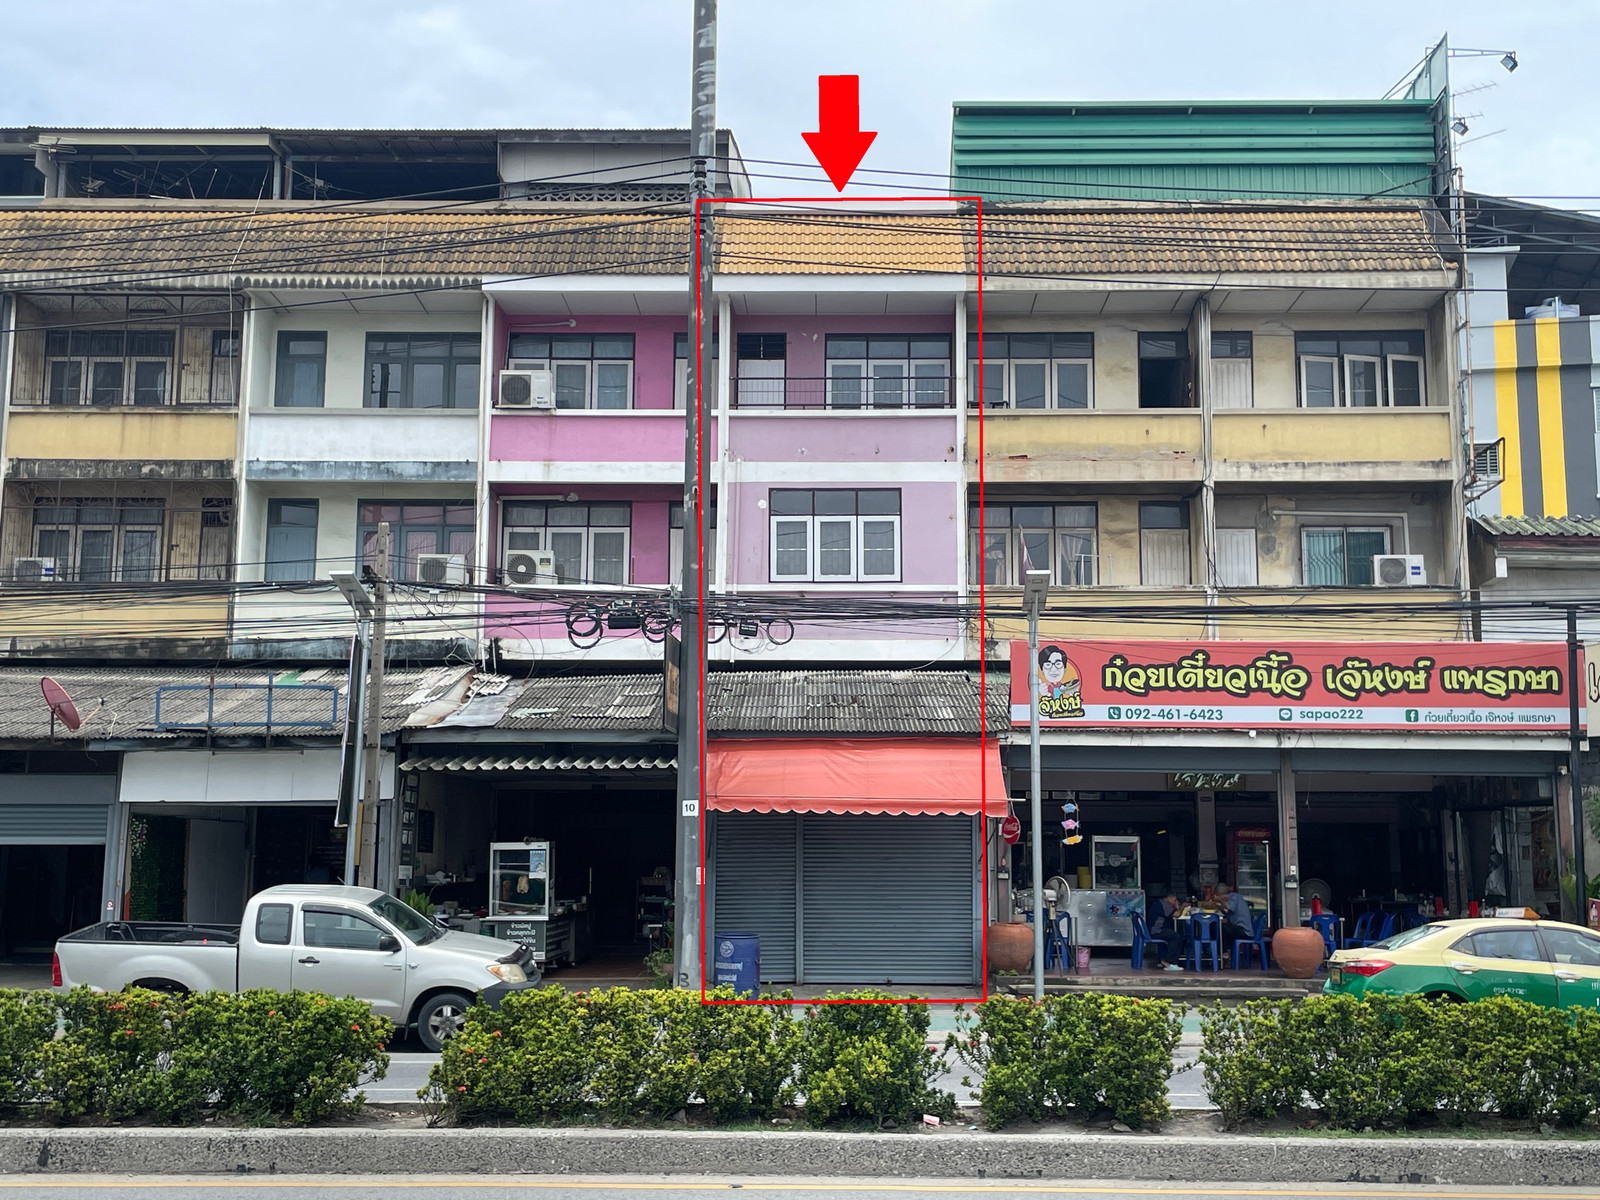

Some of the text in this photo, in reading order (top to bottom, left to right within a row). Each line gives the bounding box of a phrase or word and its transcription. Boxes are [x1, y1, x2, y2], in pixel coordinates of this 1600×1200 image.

[1104, 652, 1309, 698] ก๋วยเตี๋ยวเนื้อ
[1325, 659, 1432, 698] เจ๊หงษ์
[1442, 668, 1560, 698] แพรกษา
[1125, 708, 1223, 720] 092-461-6423
[1299, 709, 1364, 721] sapao222
[1424, 709, 1482, 723] ก๋วยเตี๋ยวเนื้อ
[1518, 714, 1556, 723] แพรกษา
[684, 804, 695, 812] 10
